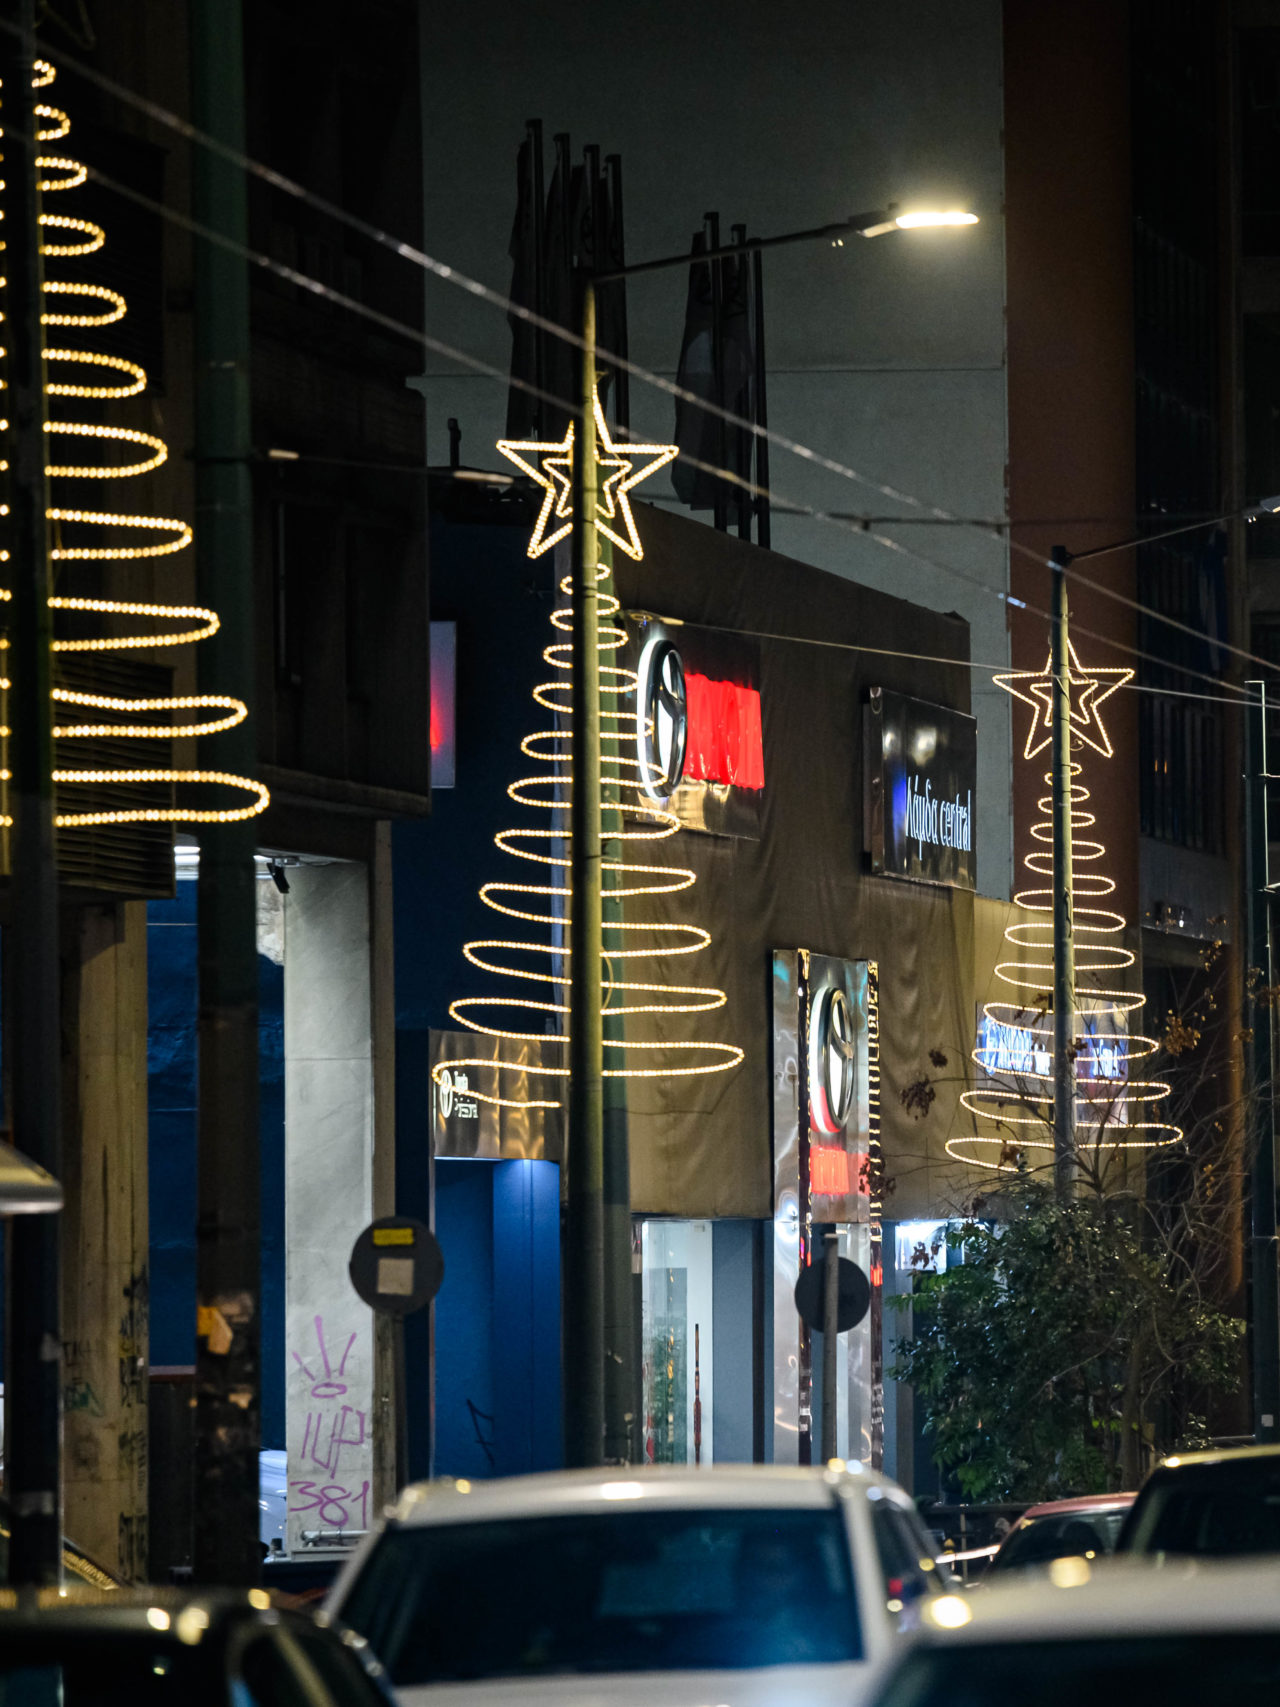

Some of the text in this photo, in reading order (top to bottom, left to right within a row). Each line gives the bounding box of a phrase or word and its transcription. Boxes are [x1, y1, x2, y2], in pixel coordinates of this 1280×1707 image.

[906, 774, 971, 860] Λάμδα central
[289, 1480, 370, 1528] 381
